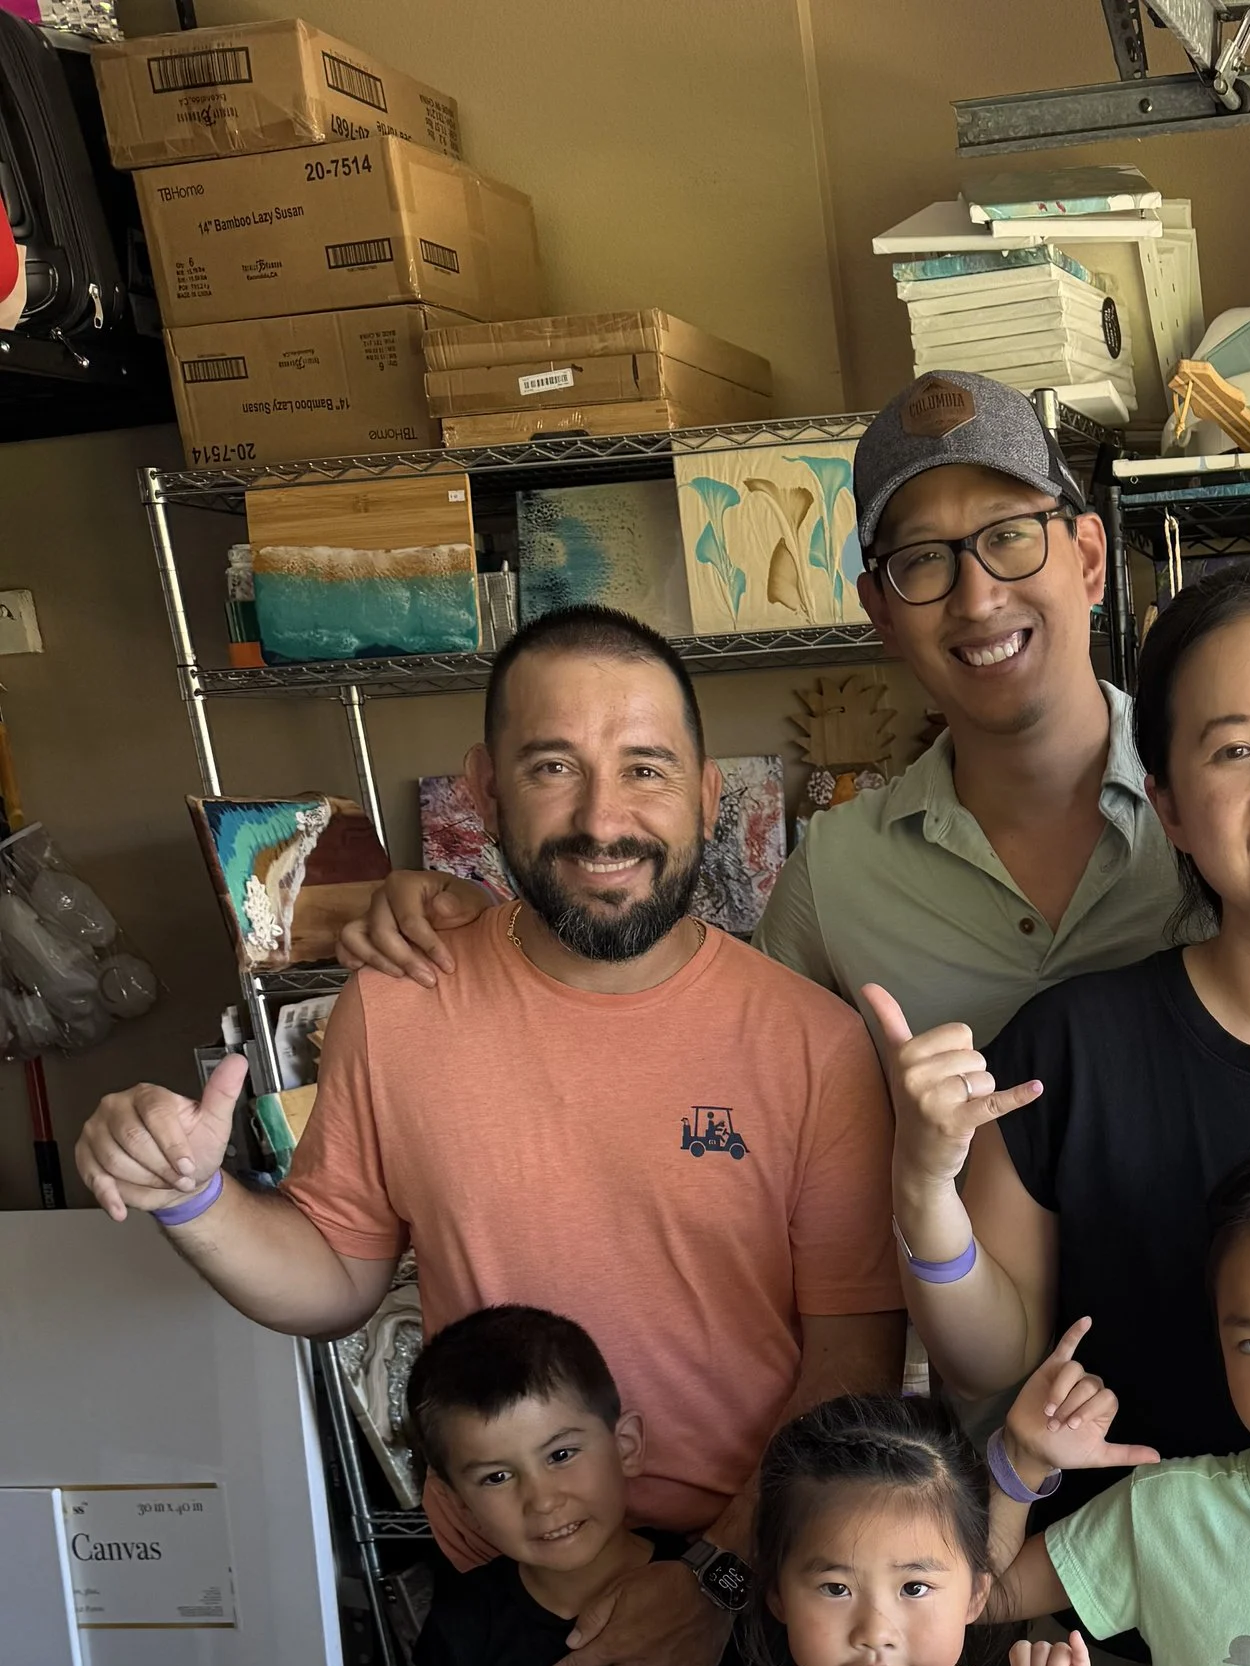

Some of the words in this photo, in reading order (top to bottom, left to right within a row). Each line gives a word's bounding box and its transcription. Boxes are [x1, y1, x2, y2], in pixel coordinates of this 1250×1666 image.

[304, 154, 372, 182] 20-7514
[157, 183, 205, 202] TBHome
[198, 220, 213, 236] 14"
[214, 212, 252, 232] Bamboo
[252, 208, 274, 226] Lazy
[274, 204, 305, 220] Susan
[242, 401, 272, 414] Susan
[272, 398, 294, 414] Lazy
[294, 398, 334, 411] Bamboo
[335, 397, 351, 410] 14"
[909, 392, 965, 418] COLUMBIA
[368, 426, 418, 440] TBHome
[192, 443, 256, 464] 20-7514
[137, 1502, 152, 1516] 30
[154, 1502, 165, 1512] in
[166, 1503, 176, 1512] x
[176, 1502, 191, 1516] 40
[192, 1500, 203, 1512] in
[72, 1533, 162, 1562] Canvas
